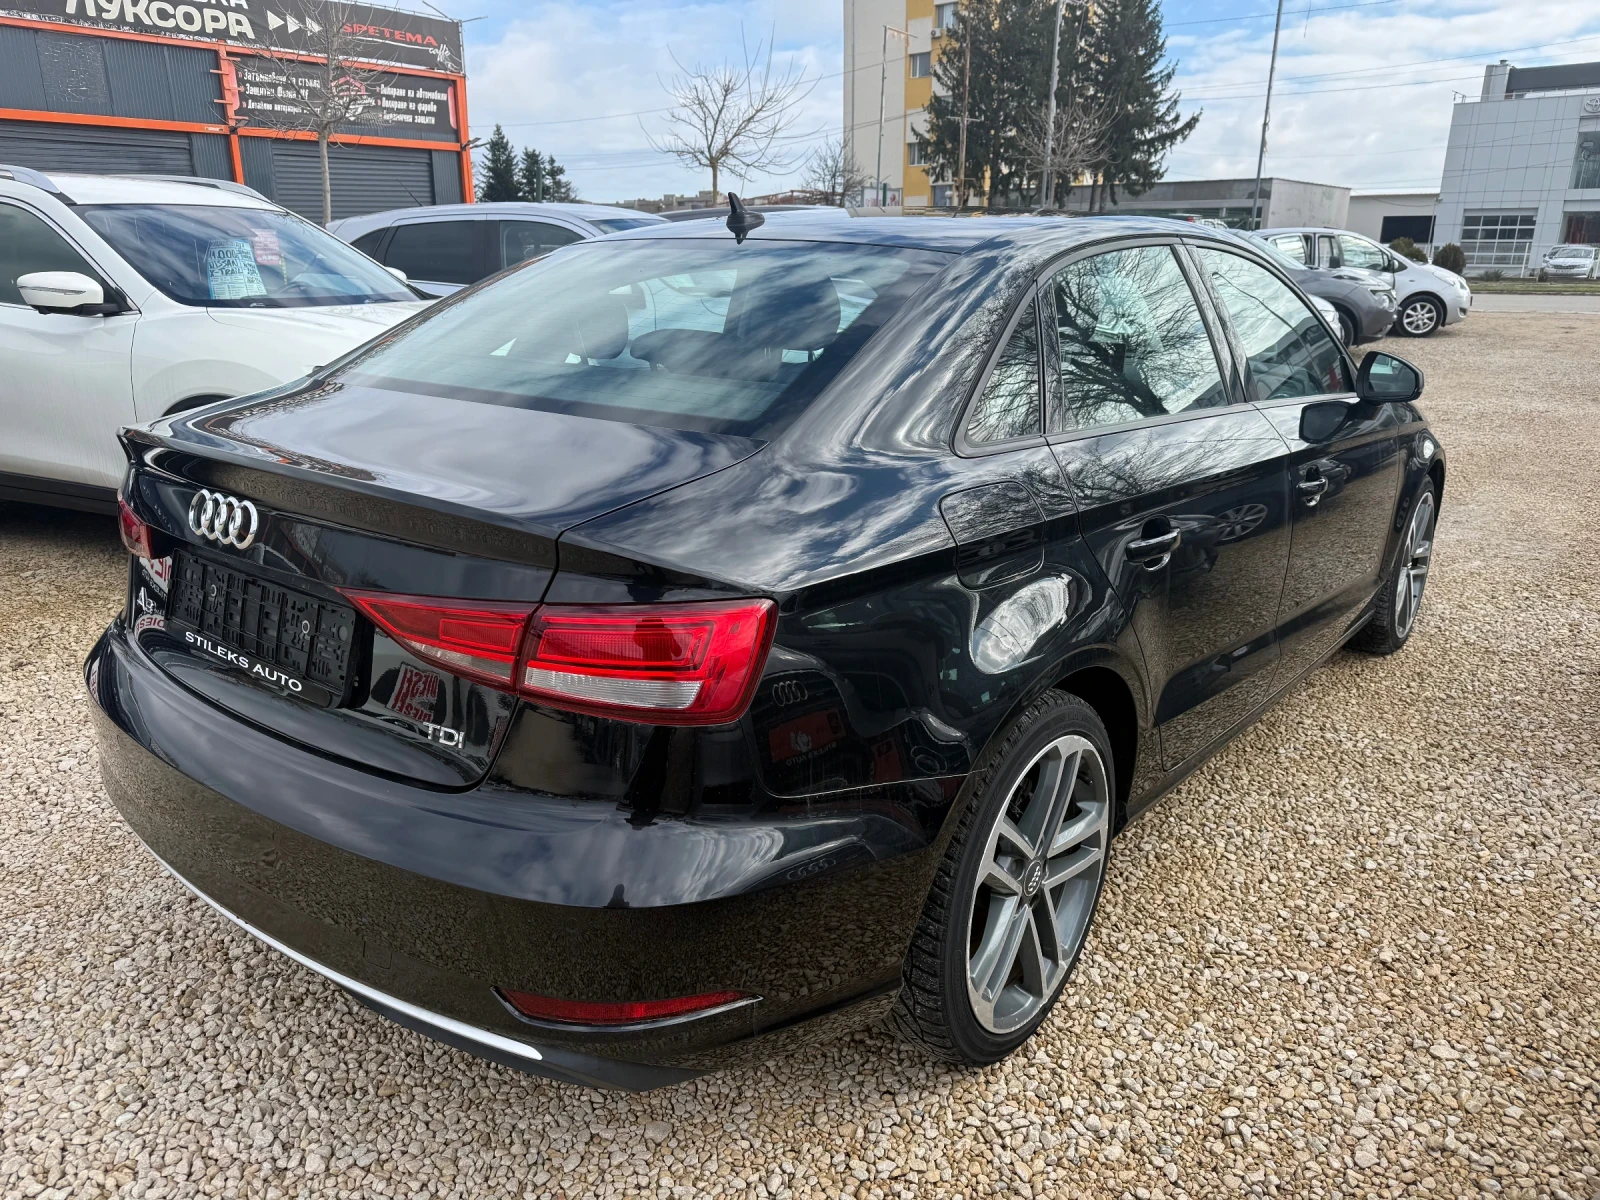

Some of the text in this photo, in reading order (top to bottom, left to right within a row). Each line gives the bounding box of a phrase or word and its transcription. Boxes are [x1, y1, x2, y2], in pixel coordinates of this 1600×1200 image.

[342, 23, 438, 46] SPETEMA
[407, 89, 415, 98] на
[408, 102, 416, 111] на
[184, 631, 303, 692] STILEKS AUTO
[423, 721, 466, 749] TDI
